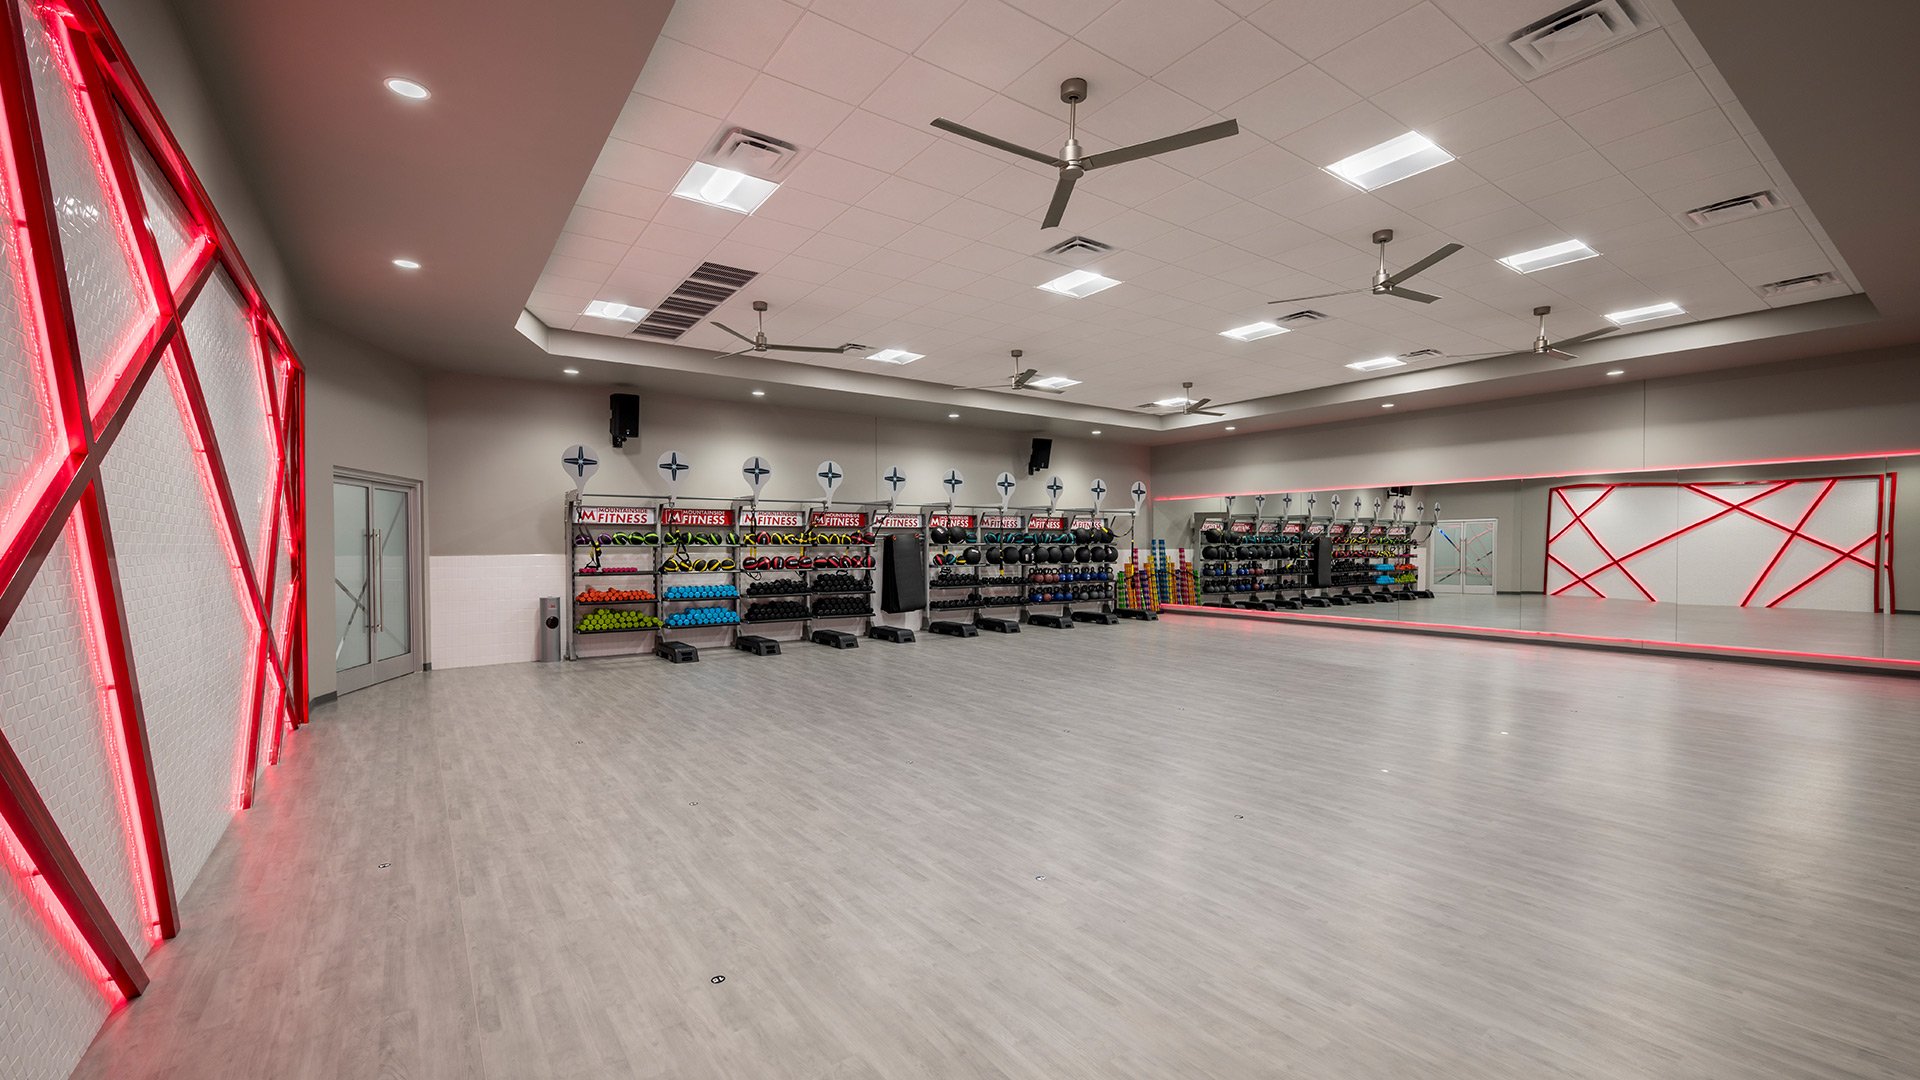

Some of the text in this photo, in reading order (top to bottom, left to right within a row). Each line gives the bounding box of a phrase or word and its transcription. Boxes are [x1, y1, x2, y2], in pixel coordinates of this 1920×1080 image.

[582, 510, 595, 521] M
[598, 513, 648, 524] FITNESS
[682, 515, 725, 525] FITNESS
[758, 516, 798, 526] FITNESS
[825, 517, 860, 527] FITNESS
[885, 518, 918, 527] FITNESS
[940, 519, 969, 528] FINESS
